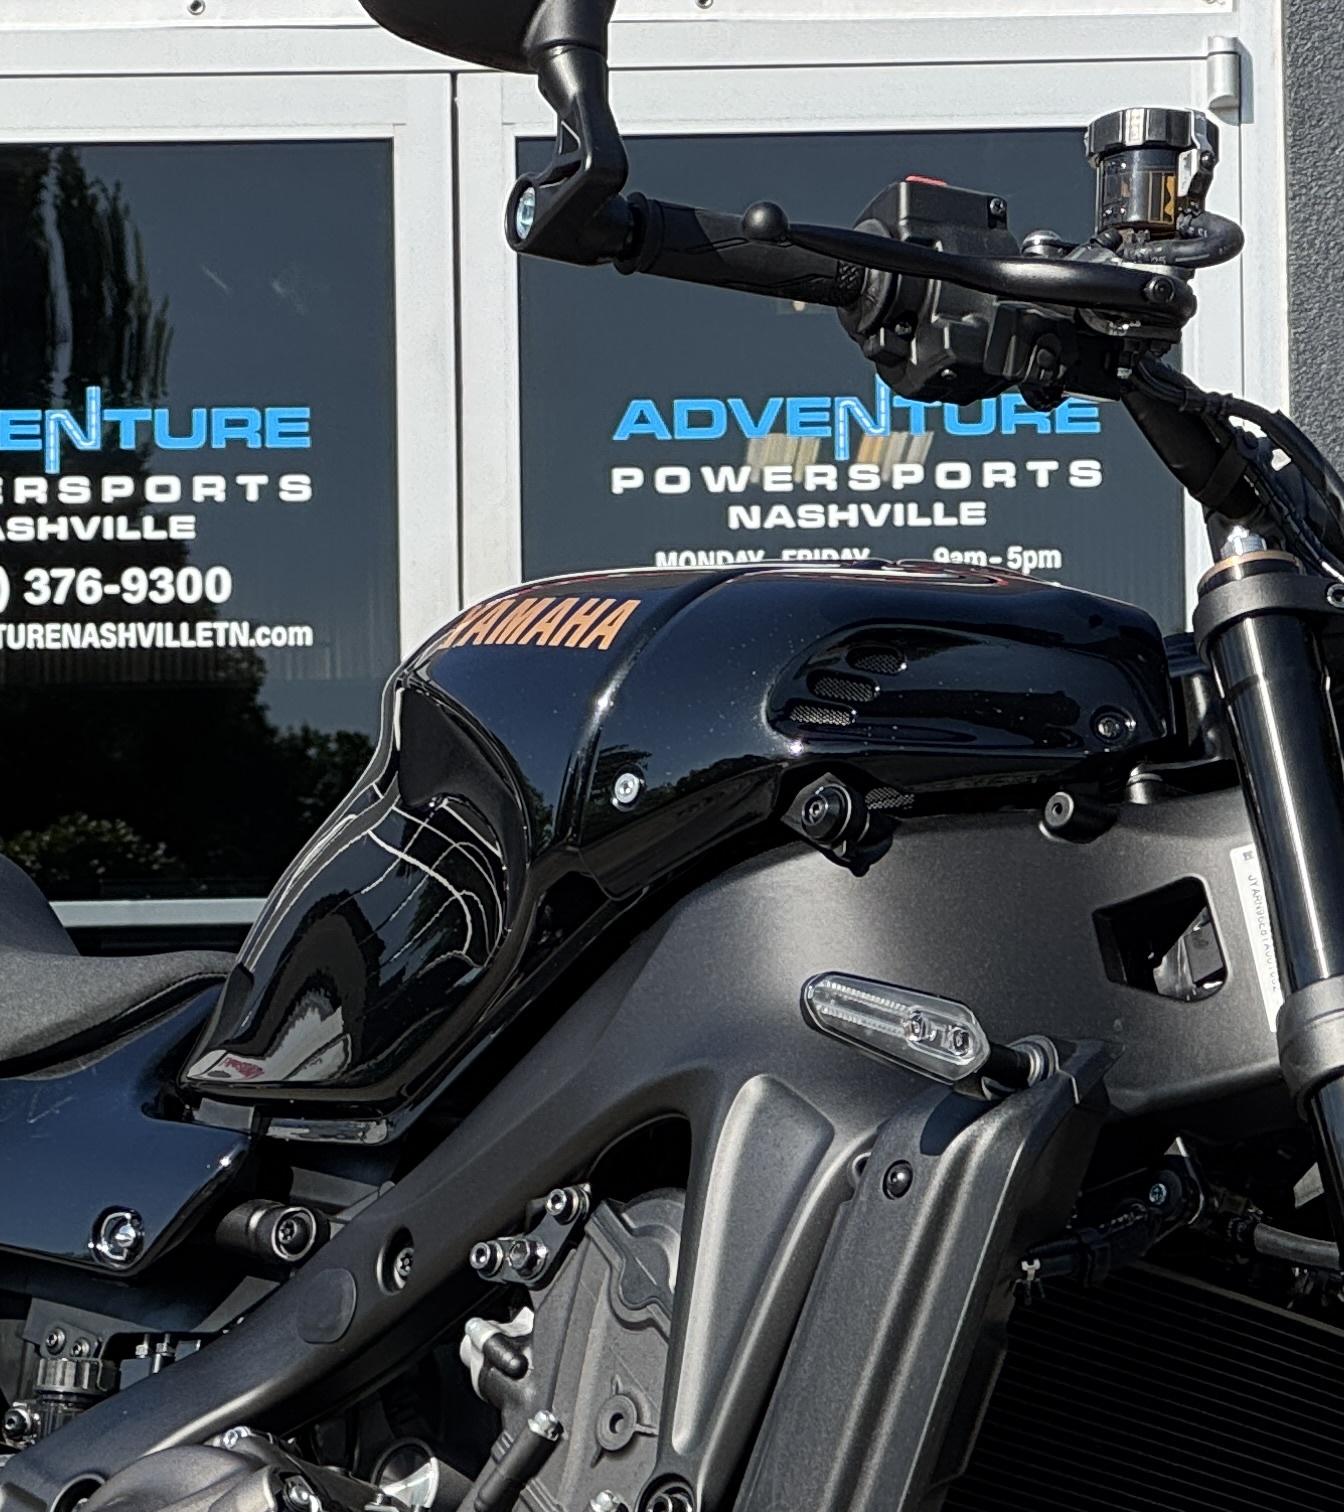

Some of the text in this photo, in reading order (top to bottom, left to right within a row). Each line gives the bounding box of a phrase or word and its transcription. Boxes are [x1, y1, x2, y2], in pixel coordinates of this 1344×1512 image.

[612, 373, 1102, 461] ADVENTURE
[611, 459, 1104, 495] POWERSPORTS
[727, 501, 988, 530] NASHVILLE
[22, 565, 233, 606] 376-9300
[442, 597, 641, 650] YAMAHA
